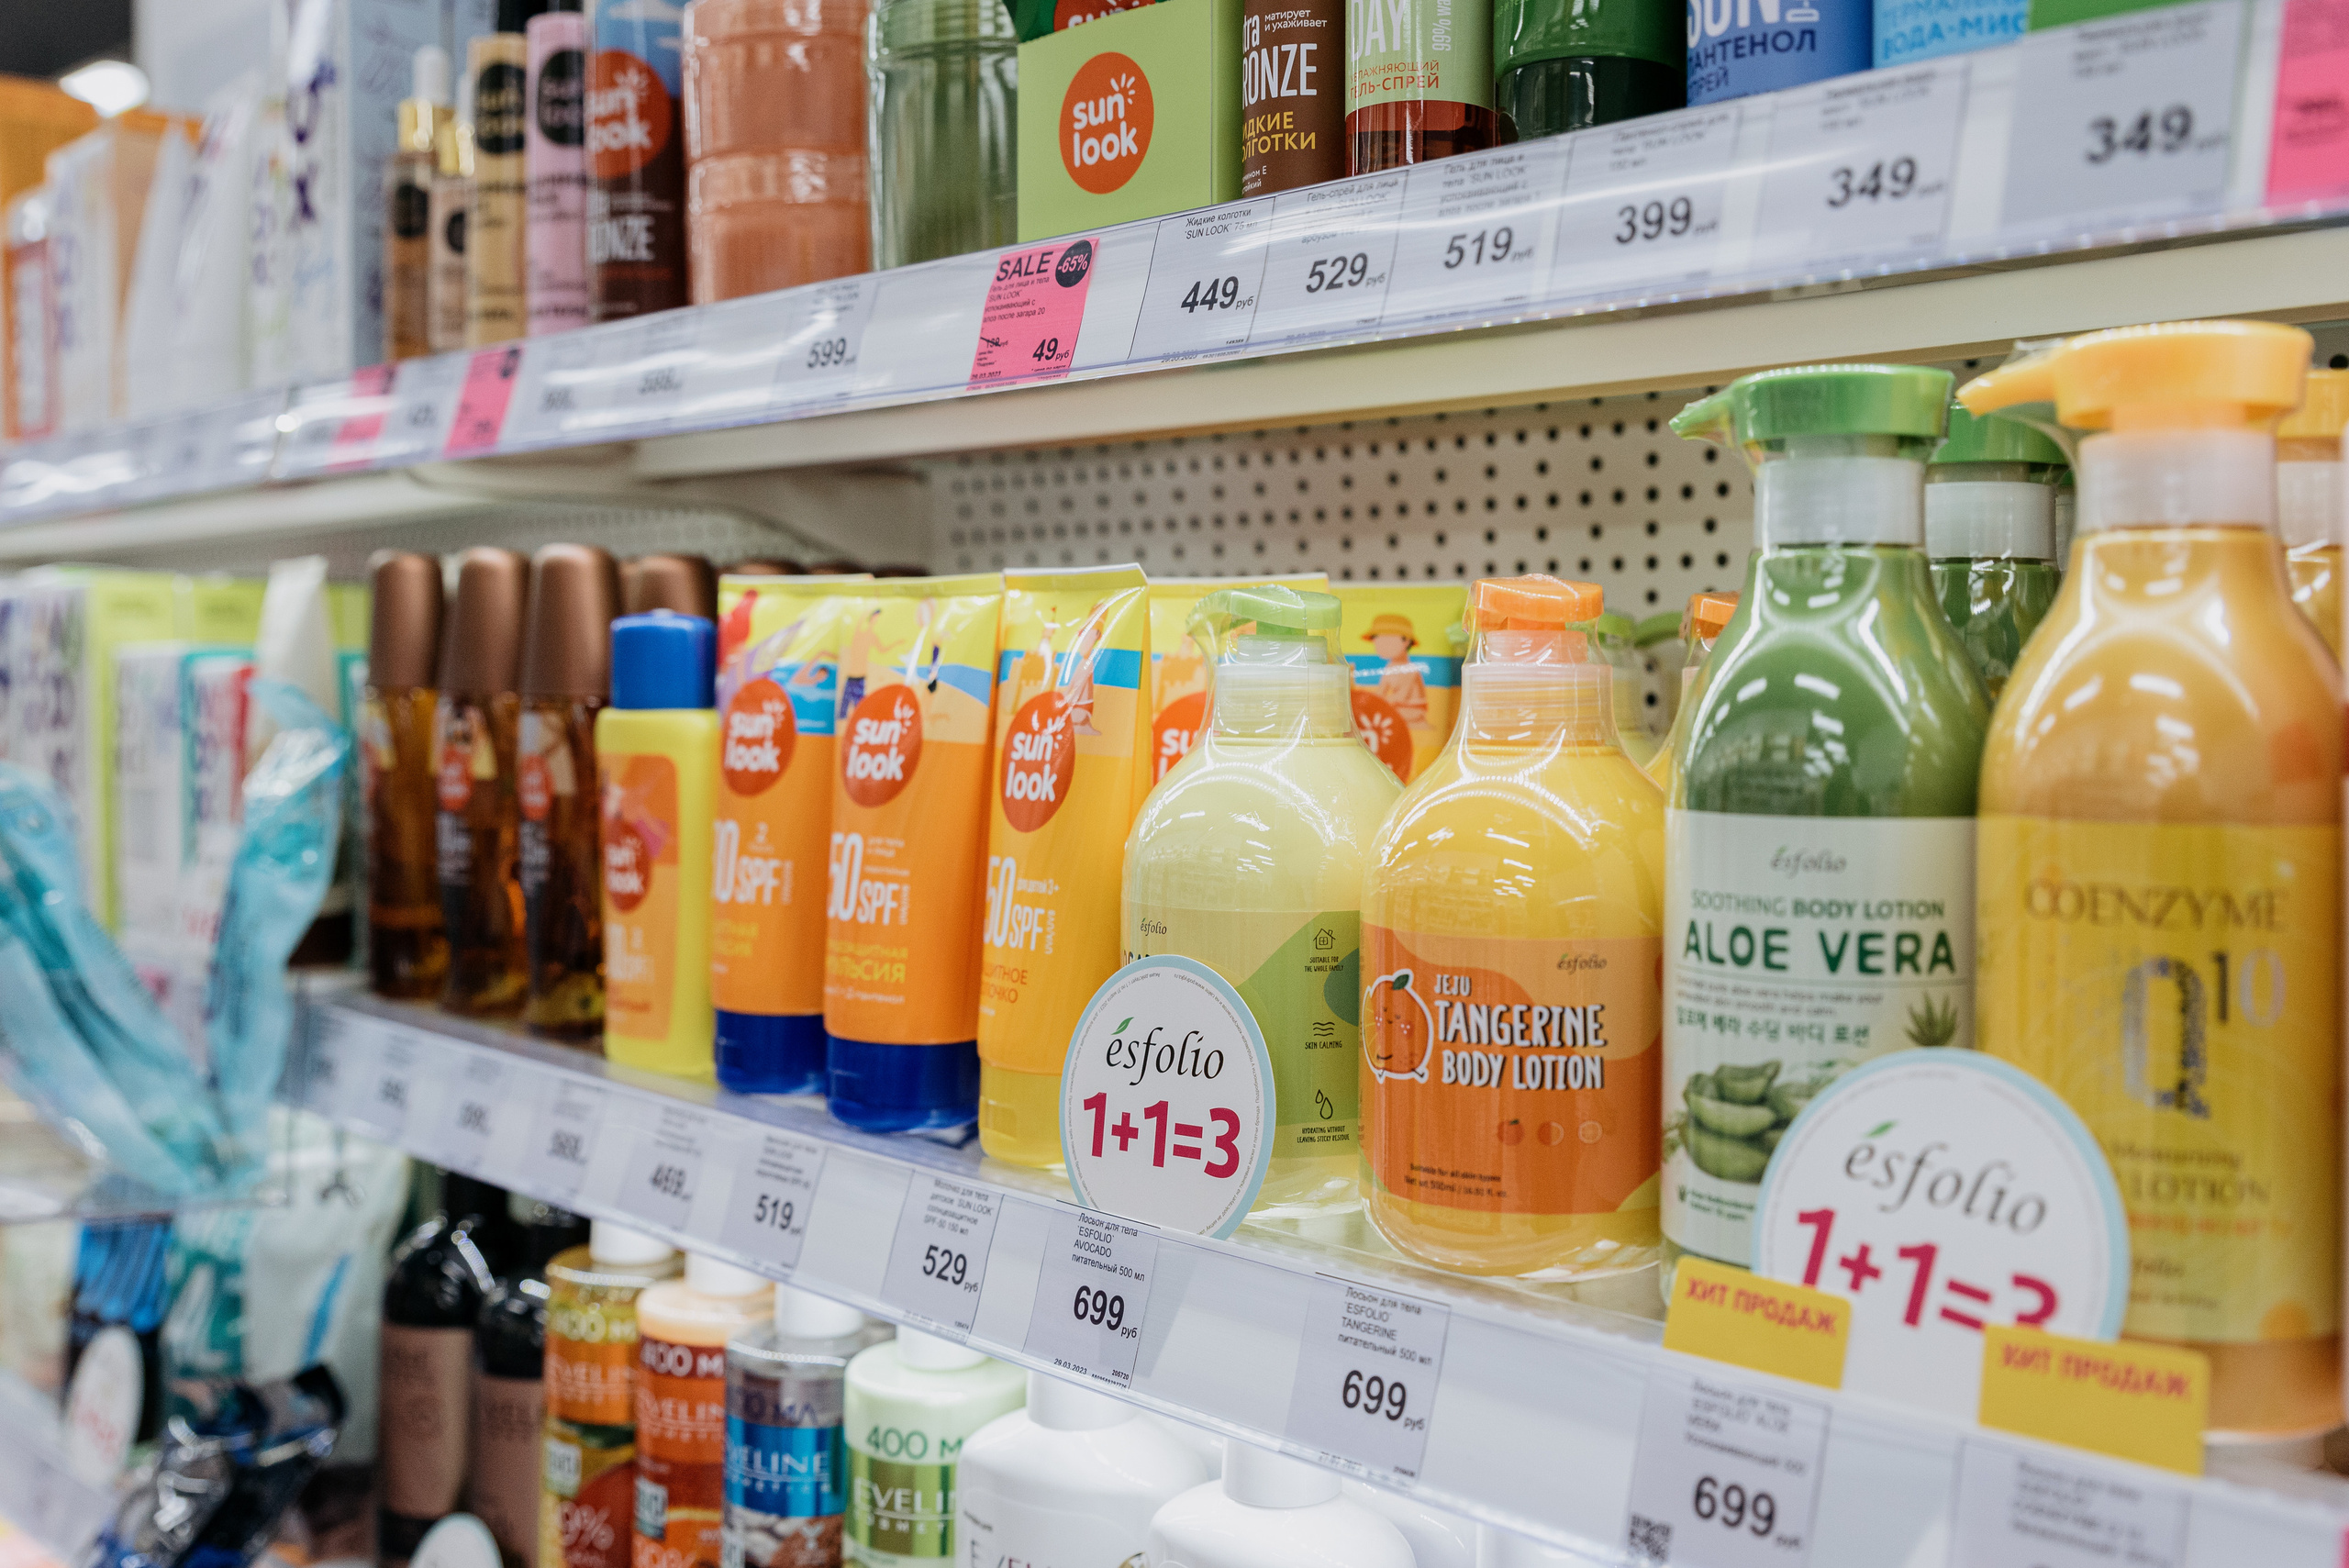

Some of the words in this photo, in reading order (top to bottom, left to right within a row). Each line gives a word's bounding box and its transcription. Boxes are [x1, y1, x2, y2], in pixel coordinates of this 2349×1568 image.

[1264, 9, 1311, 23] матирует
[1264, 23, 1272, 32] и
[1272, 17, 1328, 33] ухаживает
[1350, 0, 1404, 62] DAY
[1431, 18, 1452, 51] 99%
[1688, 28, 1817, 73] АНТЕНОЛ
[1241, 42, 1318, 110] RONZE
[1350, 60, 1440, 84] УВЛАЖНЯЮЩИЙ
[1350, 72, 1440, 101] ГЕЛЬ-СПРЕЙ
[1072, 86, 1128, 130] sun
[1241, 111, 1295, 141] ИДКИЕ
[1073, 121, 1139, 170] look
[1241, 131, 1317, 163] ОЛГОТКИ
[1825, 154, 1919, 210] 349
[1186, 215, 1216, 228] Жидкие
[1217, 208, 1252, 222] колготки
[1615, 195, 1693, 245] 399
[1057, 252, 1088, 274] -65%
[1443, 226, 1513, 270] 519
[996, 250, 1054, 283] SALE
[1015, 279, 1030, 289] лица
[1036, 276, 1050, 285] тела
[1306, 251, 1369, 294] 529
[1364, 272, 1387, 288] руб
[984, 300, 1030, 314] успокаивающий
[1180, 275, 1240, 314] 449
[1235, 295, 1255, 311] руб
[996, 310, 1016, 321] после
[1017, 308, 1037, 319] загара
[1037, 306, 1046, 316] 20
[807, 339, 848, 370] 599
[1032, 337, 1059, 361] 49
[1055, 349, 1071, 361] руб
[854, 717, 900, 745] sun
[1010, 729, 1056, 763] sun
[724, 737, 782, 773] look
[846, 746, 905, 781] look
[1005, 762, 1058, 803] look
[1770, 844, 1848, 885] ésfolio
[736, 857, 780, 906] SPF
[1047, 878, 1060, 896] 3+
[856, 879, 900, 927] SPF
[1690, 889, 1787, 917] SOOTHING
[1790, 896, 1859, 919] BODY
[1863, 897, 1945, 920] LOTION
[2024, 875, 2290, 932] COENZYME
[1008, 904, 1046, 952] SPF
[1140, 917, 1167, 937] ésfolio
[1330, 955, 1340, 963] FOR
[1556, 952, 1608, 976] ésfolio
[1683, 919, 1790, 972] ALOE
[1818, 929, 1956, 976] VERA
[1130, 973, 1149, 984] действует
[1313, 964, 1329, 973] WHOLE
[1329, 964, 1344, 973] FAMILY
[1433, 973, 1473, 997] JEJU
[1433, 999, 1609, 1049] TANGERINE
[1105, 1016, 1225, 1086] ésfolio
[1305, 1041, 1318, 1050] SKIN
[1319, 1040, 1343, 1050] CALMING
[1442, 1049, 1508, 1090] BODY
[1511, 1053, 1605, 1092] LOTION
[1083, 1091, 1241, 1179] 1+1=3
[1297, 1136, 1317, 1144] LEAVING
[1317, 1135, 1332, 1143] STICKY
[1331, 1133, 1350, 1142] RESIDUE
[1301, 1127, 1327, 1135] HYDRATING
[1327, 1125, 1346, 1134] WITHOUT
[1204, 1218, 1218, 1231] Акция
[1219, 1194, 1238, 1217] действует
[1247, 1148, 1255, 1165] маски
[1251, 1066, 1260, 1104] Подробности
[934, 1178, 961, 1195] Молочко
[961, 1186, 974, 1197] для
[974, 1190, 989, 1202] тела
[1843, 1118, 2048, 1236] ésfolio
[754, 1193, 795, 1231] 519
[1078, 1212, 1105, 1229] Лосьон
[1105, 1221, 1119, 1233] для
[1120, 1225, 1139, 1238] тела
[1073, 1239, 1113, 1259] AVOCADO
[922, 1244, 968, 1285] 529
[963, 1282, 979, 1294] руб
[1071, 1253, 1119, 1275] питательный
[1119, 1265, 1134, 1278] 500
[1133, 1272, 1146, 1283] мл
[1074, 1284, 1126, 1331] 699
[1120, 1325, 1139, 1340] руб
[1345, 1286, 1378, 1304] Лосьон
[1379, 1297, 1398, 1310] для
[1400, 1302, 1422, 1316] тела
[1685, 1275, 1730, 1308] ХИТ
[1731, 1286, 1839, 1338] ПРОДАЖ
[1341, 1316, 1398, 1342] TANGERINE
[1053, 1357, 1088, 1375] 29.03.2023
[1337, 1333, 1397, 1357] питательный
[1399, 1348, 1417, 1362] 500
[1419, 1354, 1432, 1367] мл
[1111, 1369, 1130, 1382] 205720
[1999, 1341, 2052, 1375] ХИТ
[2058, 1348, 2193, 1405] ПРОДАЖ
[1341, 1369, 1408, 1421] 699
[1403, 1416, 1426, 1431] руб
[865, 1425, 929, 1461] 400
[1694, 1474, 1777, 1539] 699
